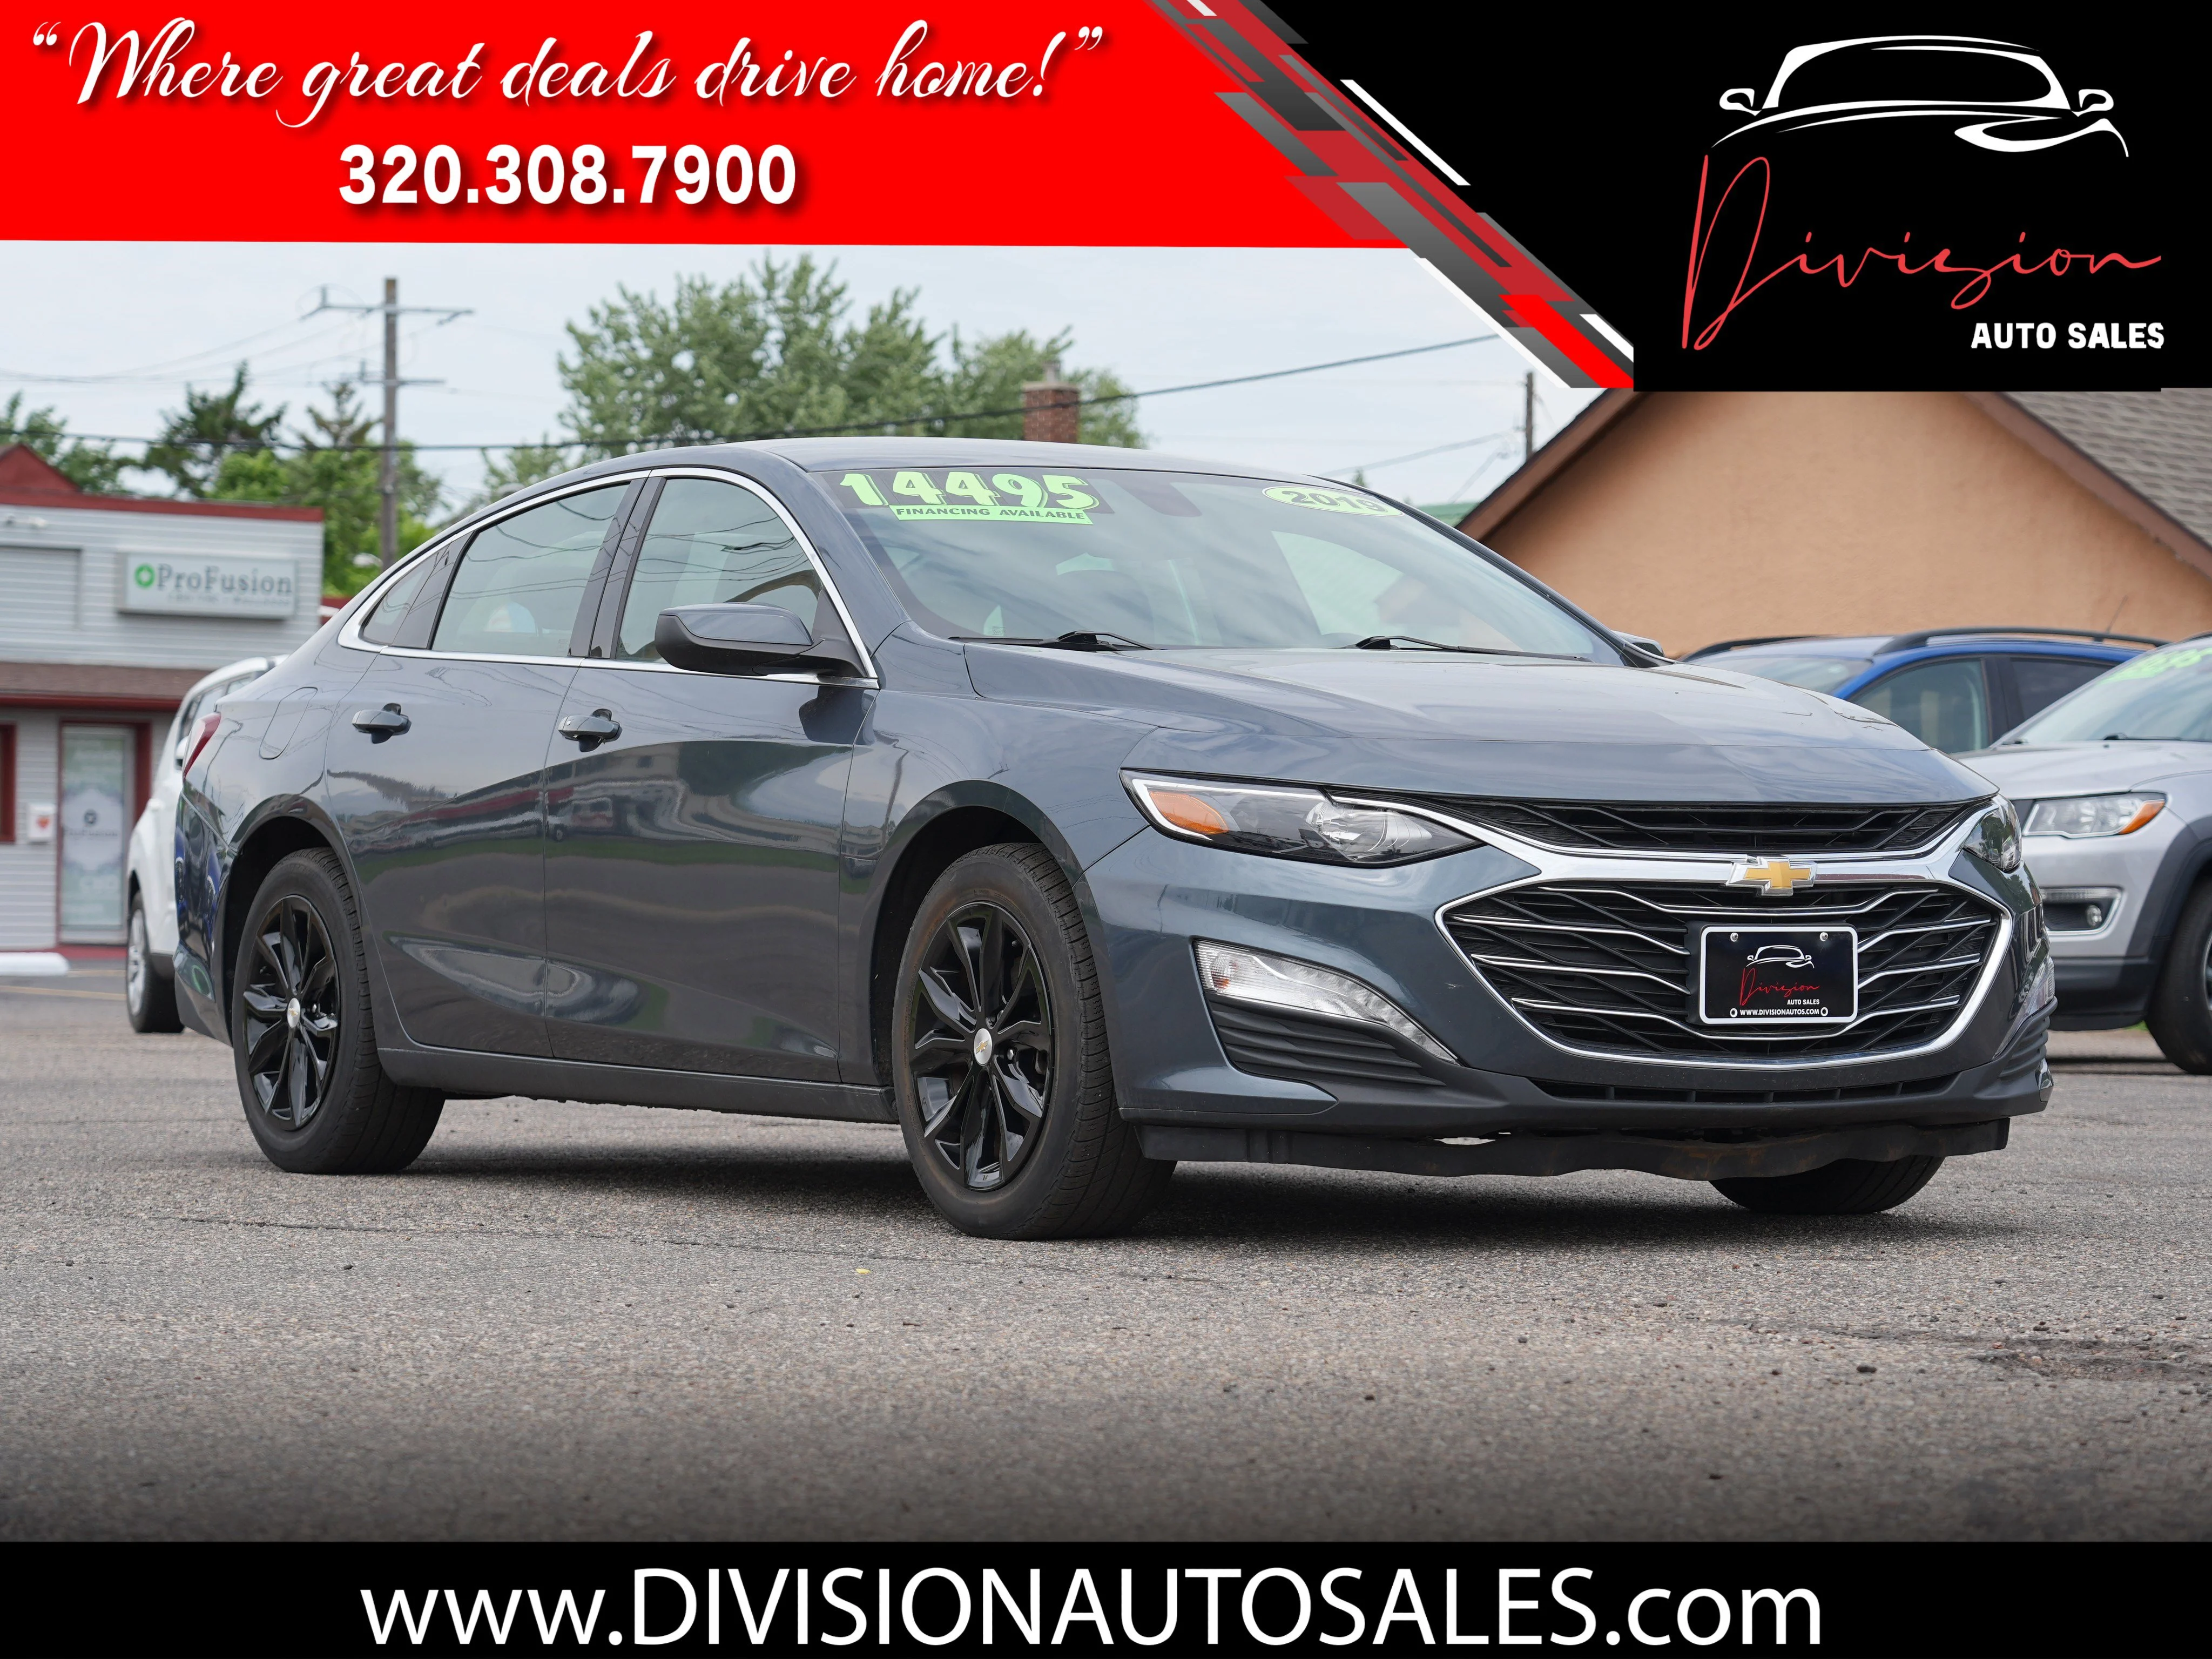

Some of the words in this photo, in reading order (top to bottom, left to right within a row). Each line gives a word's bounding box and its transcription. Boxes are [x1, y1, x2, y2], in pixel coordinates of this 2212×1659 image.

[840, 471, 1100, 509] 14495
[1282, 490, 1388, 513] 2019
[896, 508, 990, 516] FINANCING
[999, 509, 1085, 520] AVAILABLE
[157, 563, 293, 593] ProFusion
[1740, 968, 1820, 1006] Division
